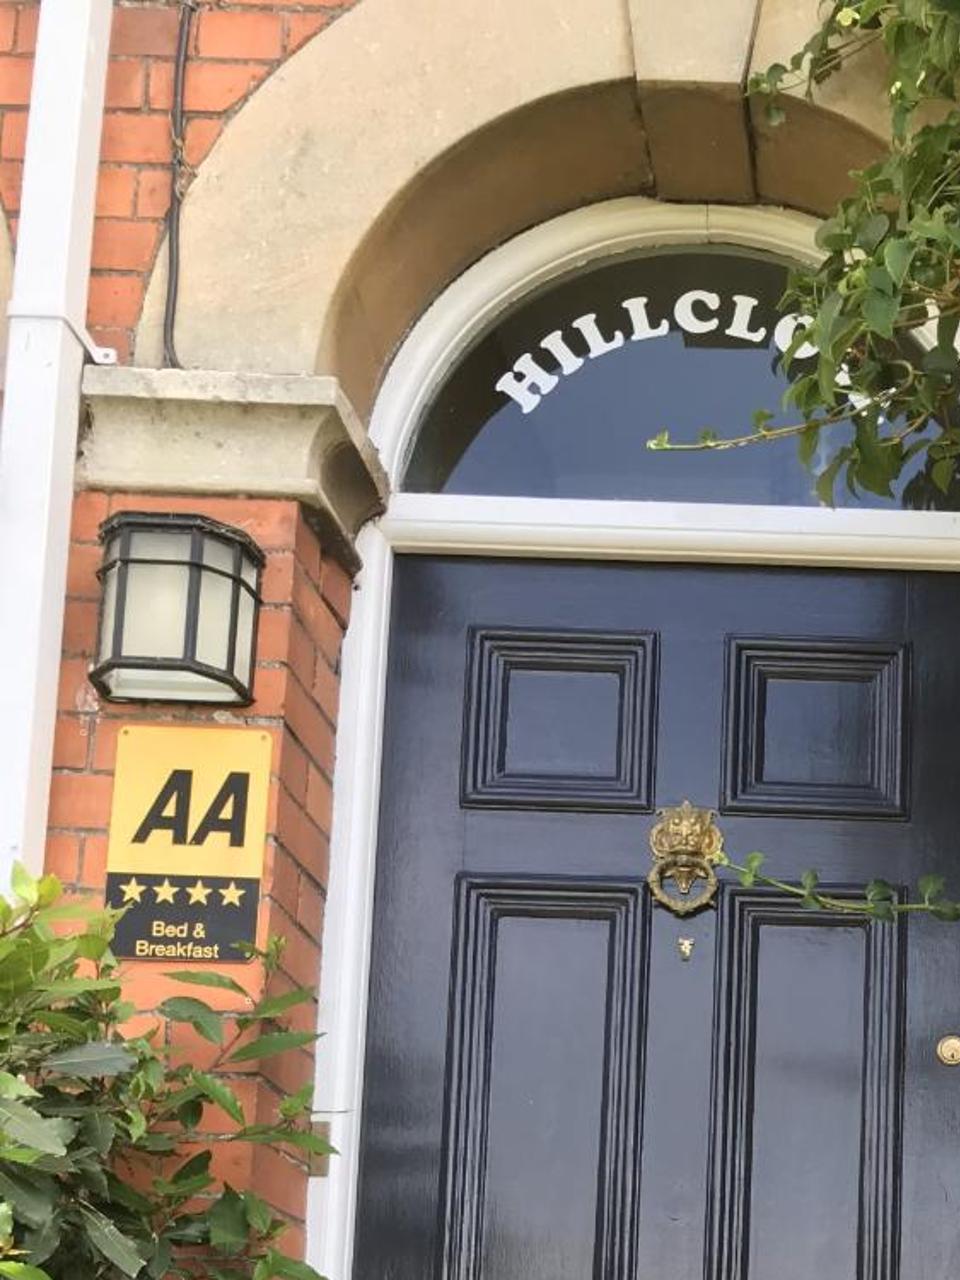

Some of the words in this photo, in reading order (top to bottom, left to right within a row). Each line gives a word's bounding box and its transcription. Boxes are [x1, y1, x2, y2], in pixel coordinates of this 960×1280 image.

[131, 769, 250, 848] AA
[152, 920, 188, 938] Bed
[192, 922, 206, 938] &
[135, 940, 219, 959] Breakfast
